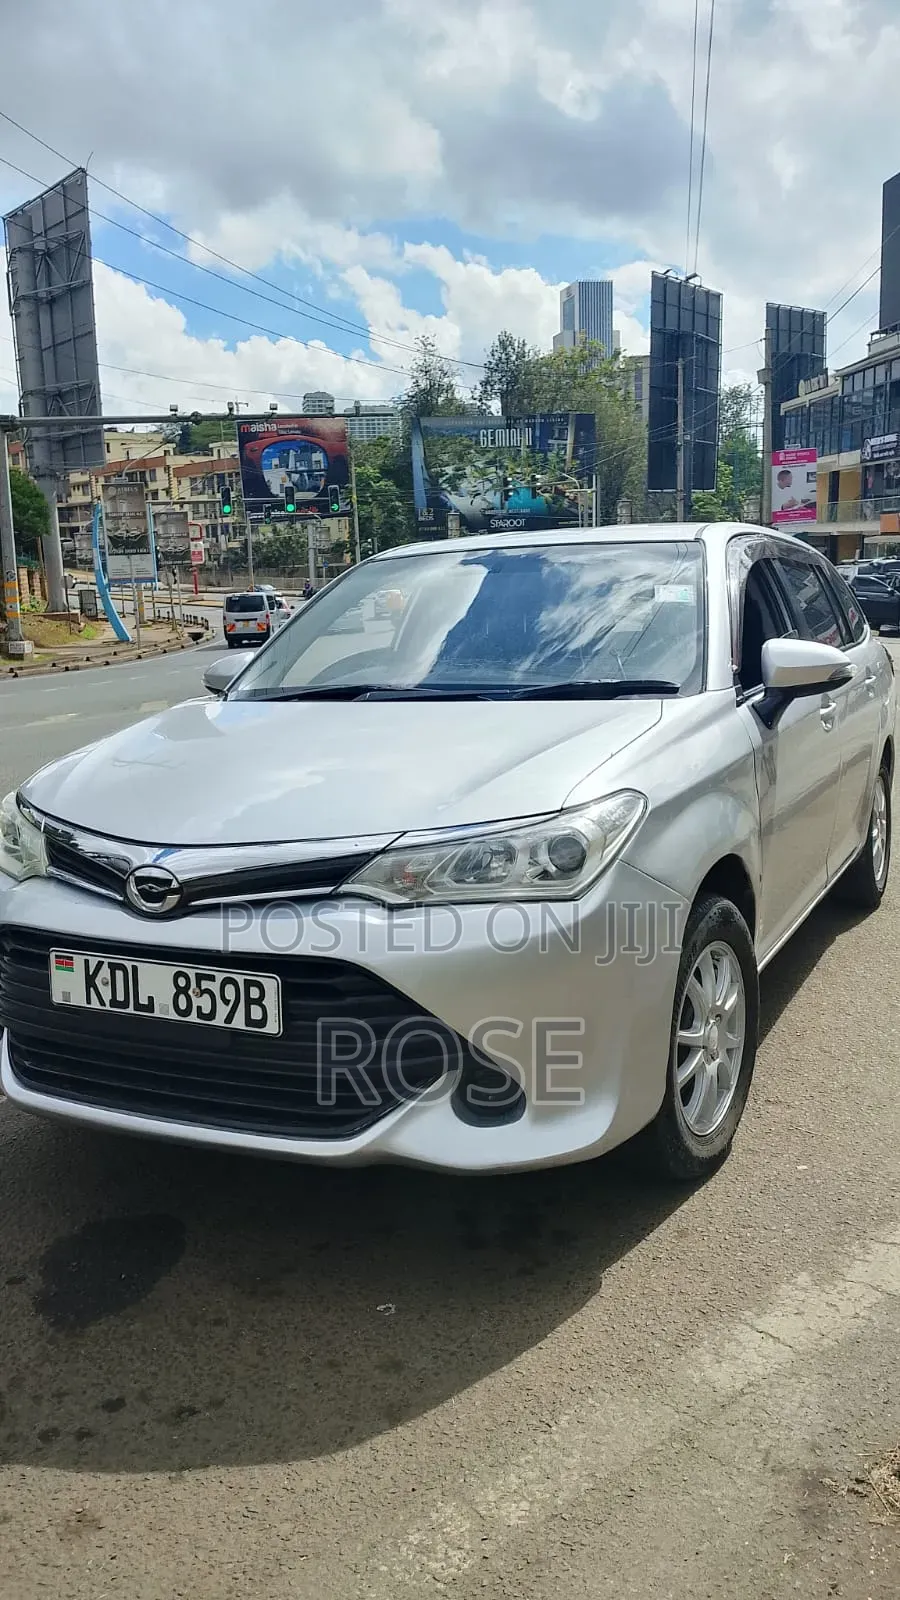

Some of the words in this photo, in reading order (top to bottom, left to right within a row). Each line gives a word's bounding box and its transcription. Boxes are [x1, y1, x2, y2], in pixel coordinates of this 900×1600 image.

[241, 422, 277, 433] maisha
[490, 518, 526, 528] STAROOT
[84, 958, 155, 1014] KDL
[172, 970, 268, 1029] 859B
